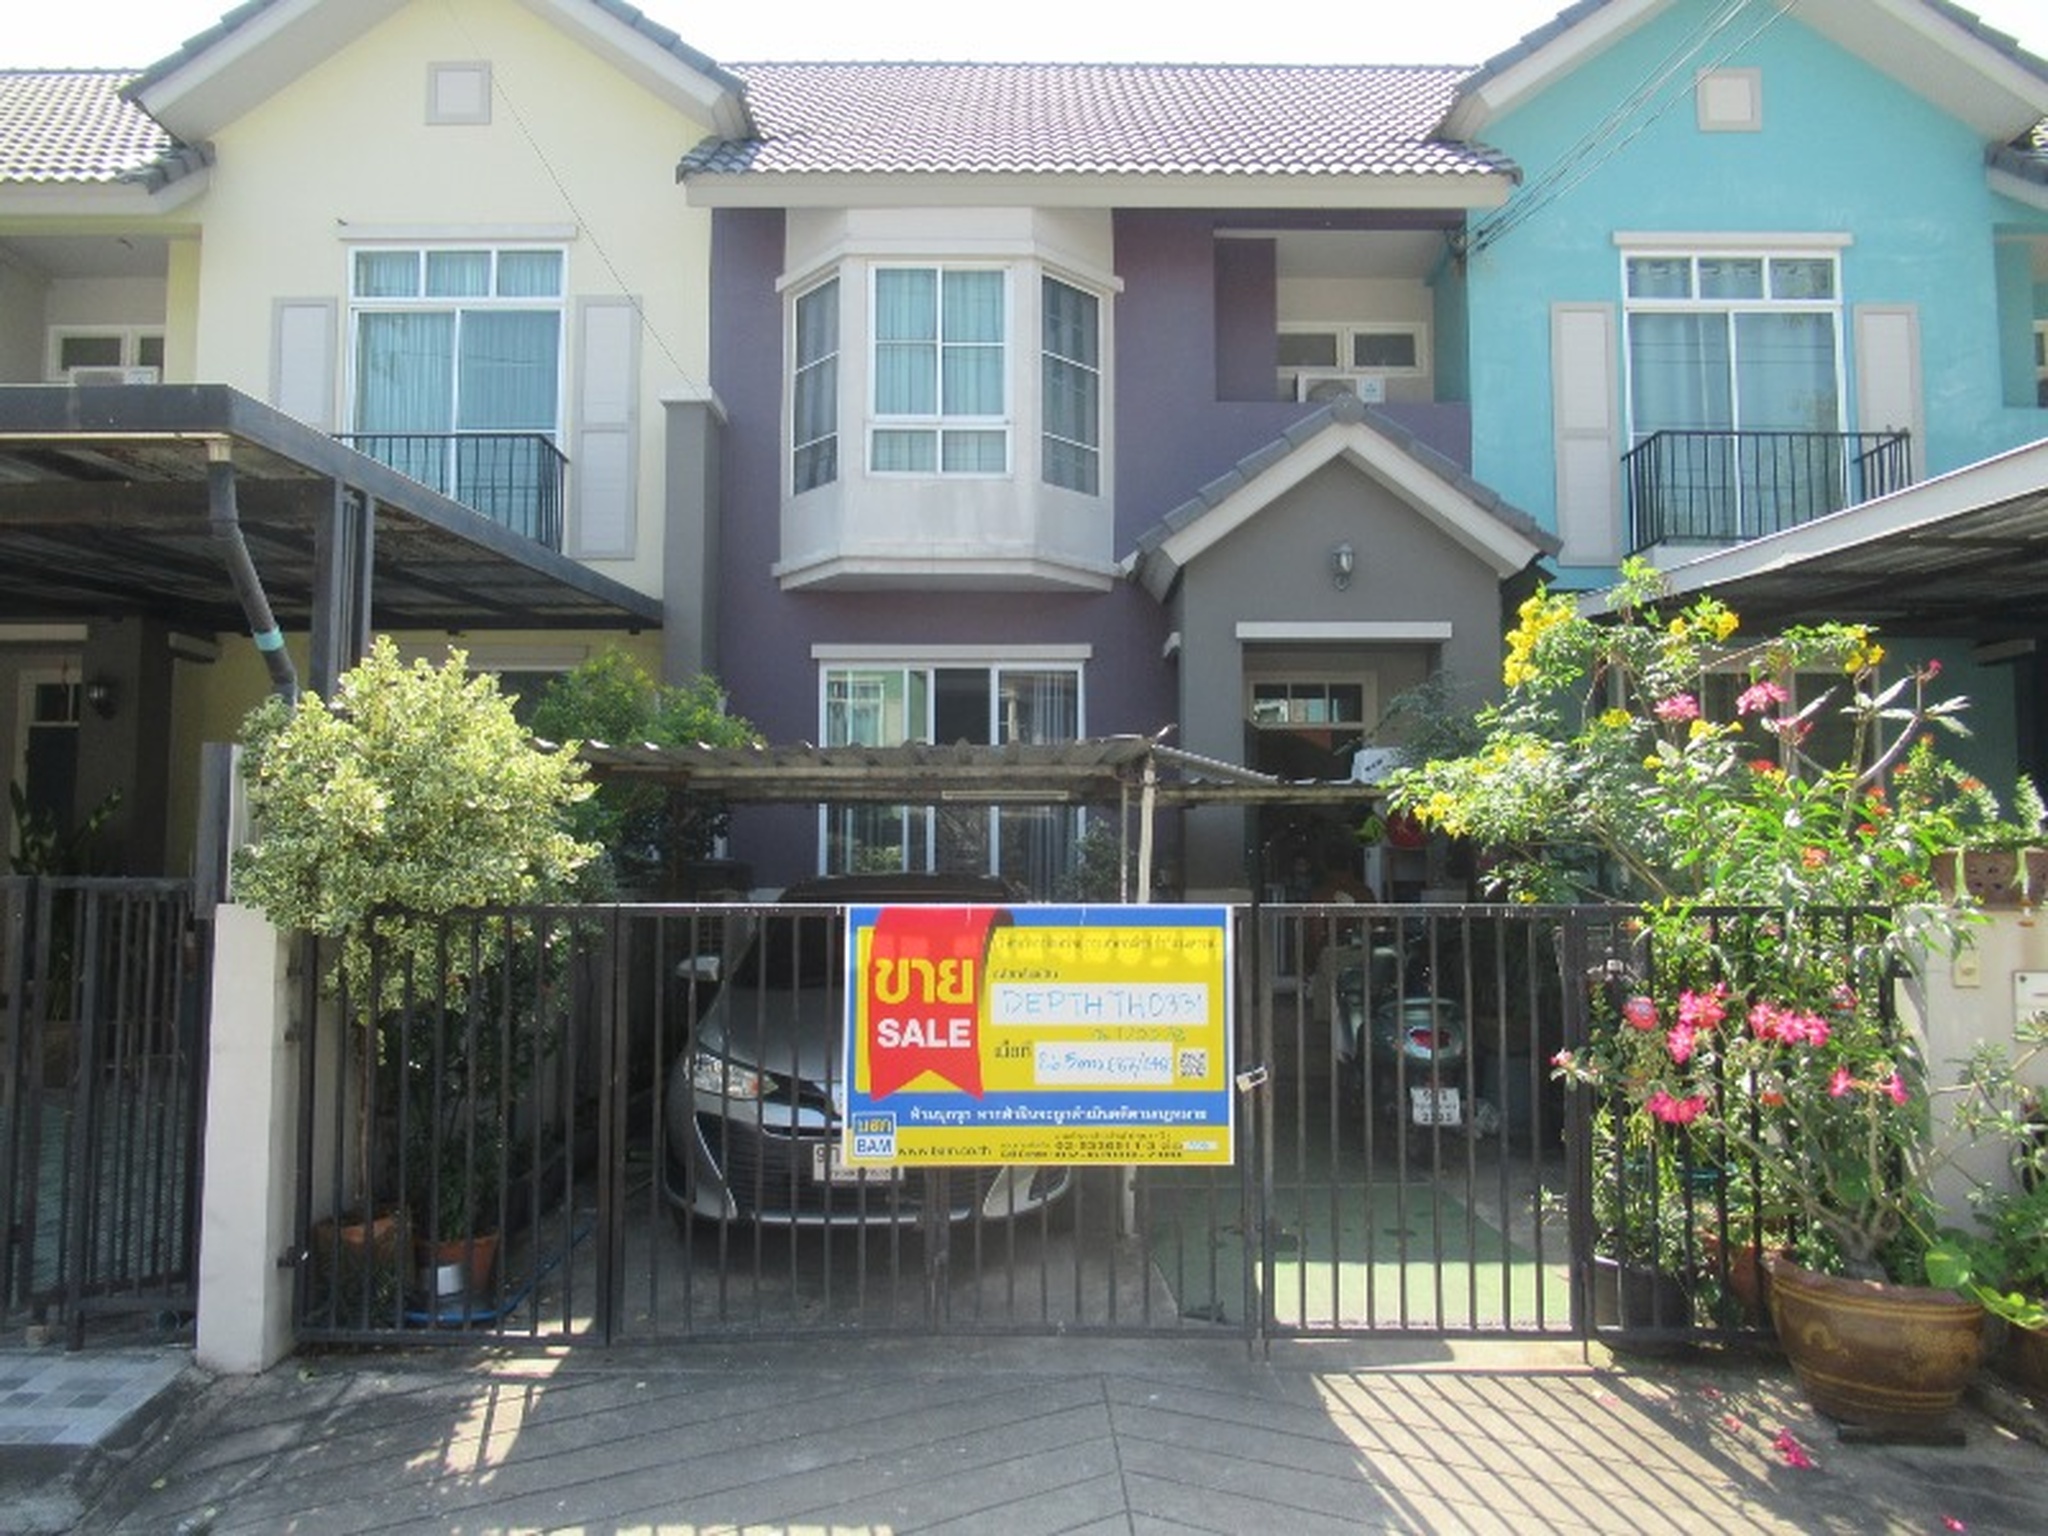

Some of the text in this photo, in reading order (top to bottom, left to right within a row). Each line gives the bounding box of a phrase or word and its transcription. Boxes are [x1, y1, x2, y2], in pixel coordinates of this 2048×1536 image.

[875, 958, 974, 1004] ขาย
[877, 1018, 971, 1048] SALE
[857, 1138, 892, 1153] BAM
